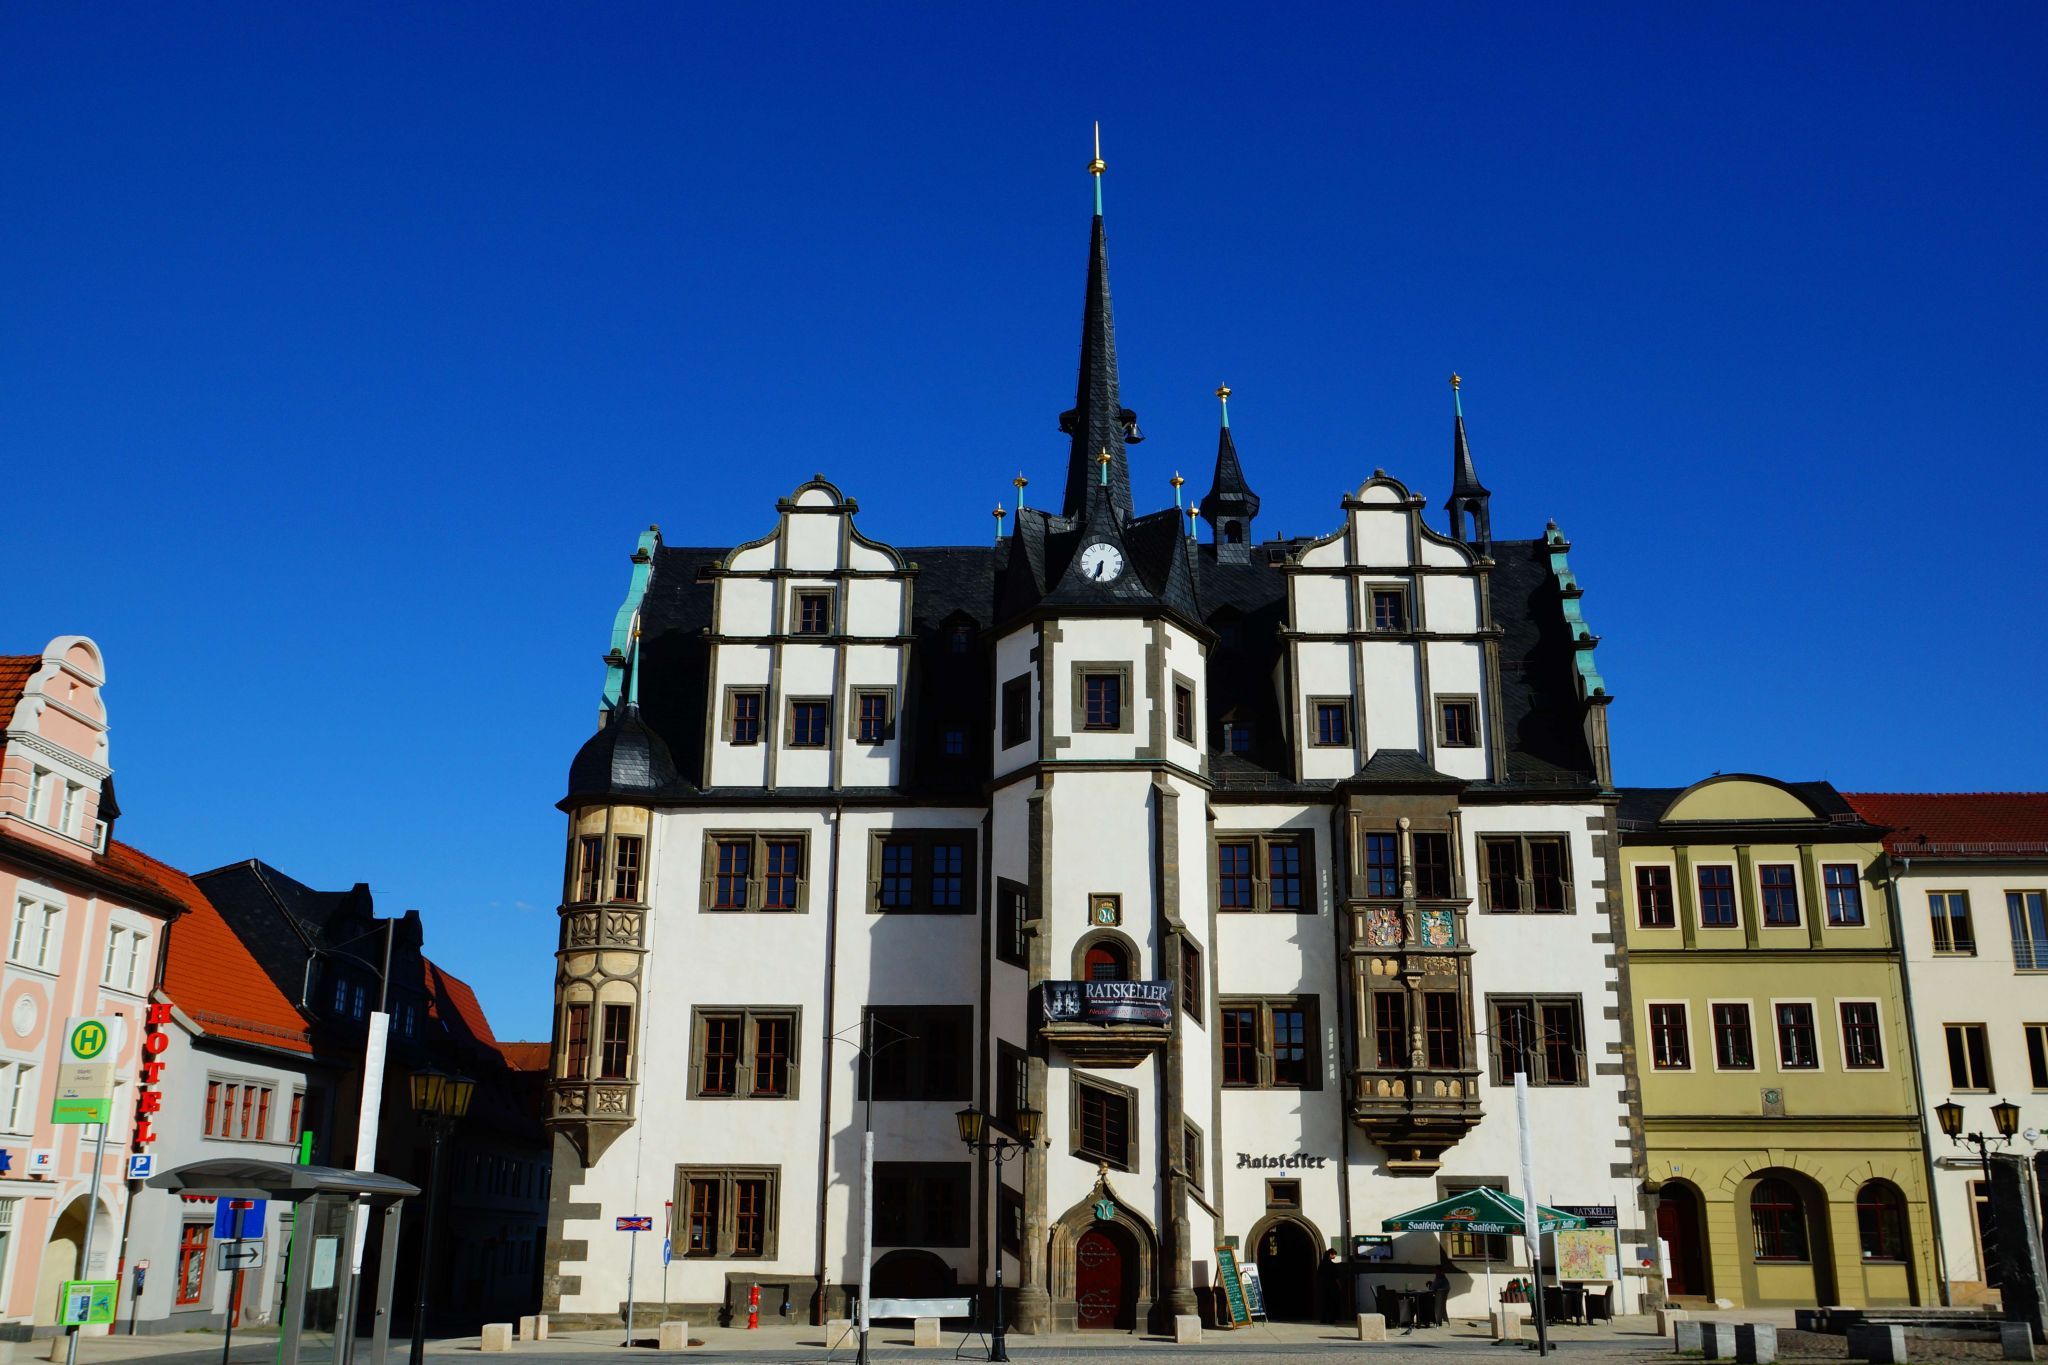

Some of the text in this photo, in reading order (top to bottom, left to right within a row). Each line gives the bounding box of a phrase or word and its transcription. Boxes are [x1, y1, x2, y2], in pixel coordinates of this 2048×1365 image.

[1085, 983, 1167, 1001] RATSKELLER
[80, 1029, 98, 1050] H
[136, 1003, 174, 1142] HOTEL
[135, 1157, 147, 1168] P
[1236, 1152, 1327, 1169] Ratskeller
[1573, 1207, 1616, 1216] RATSKELLER
[1407, 1221, 1504, 1233] Saalfelder Saalfelder
